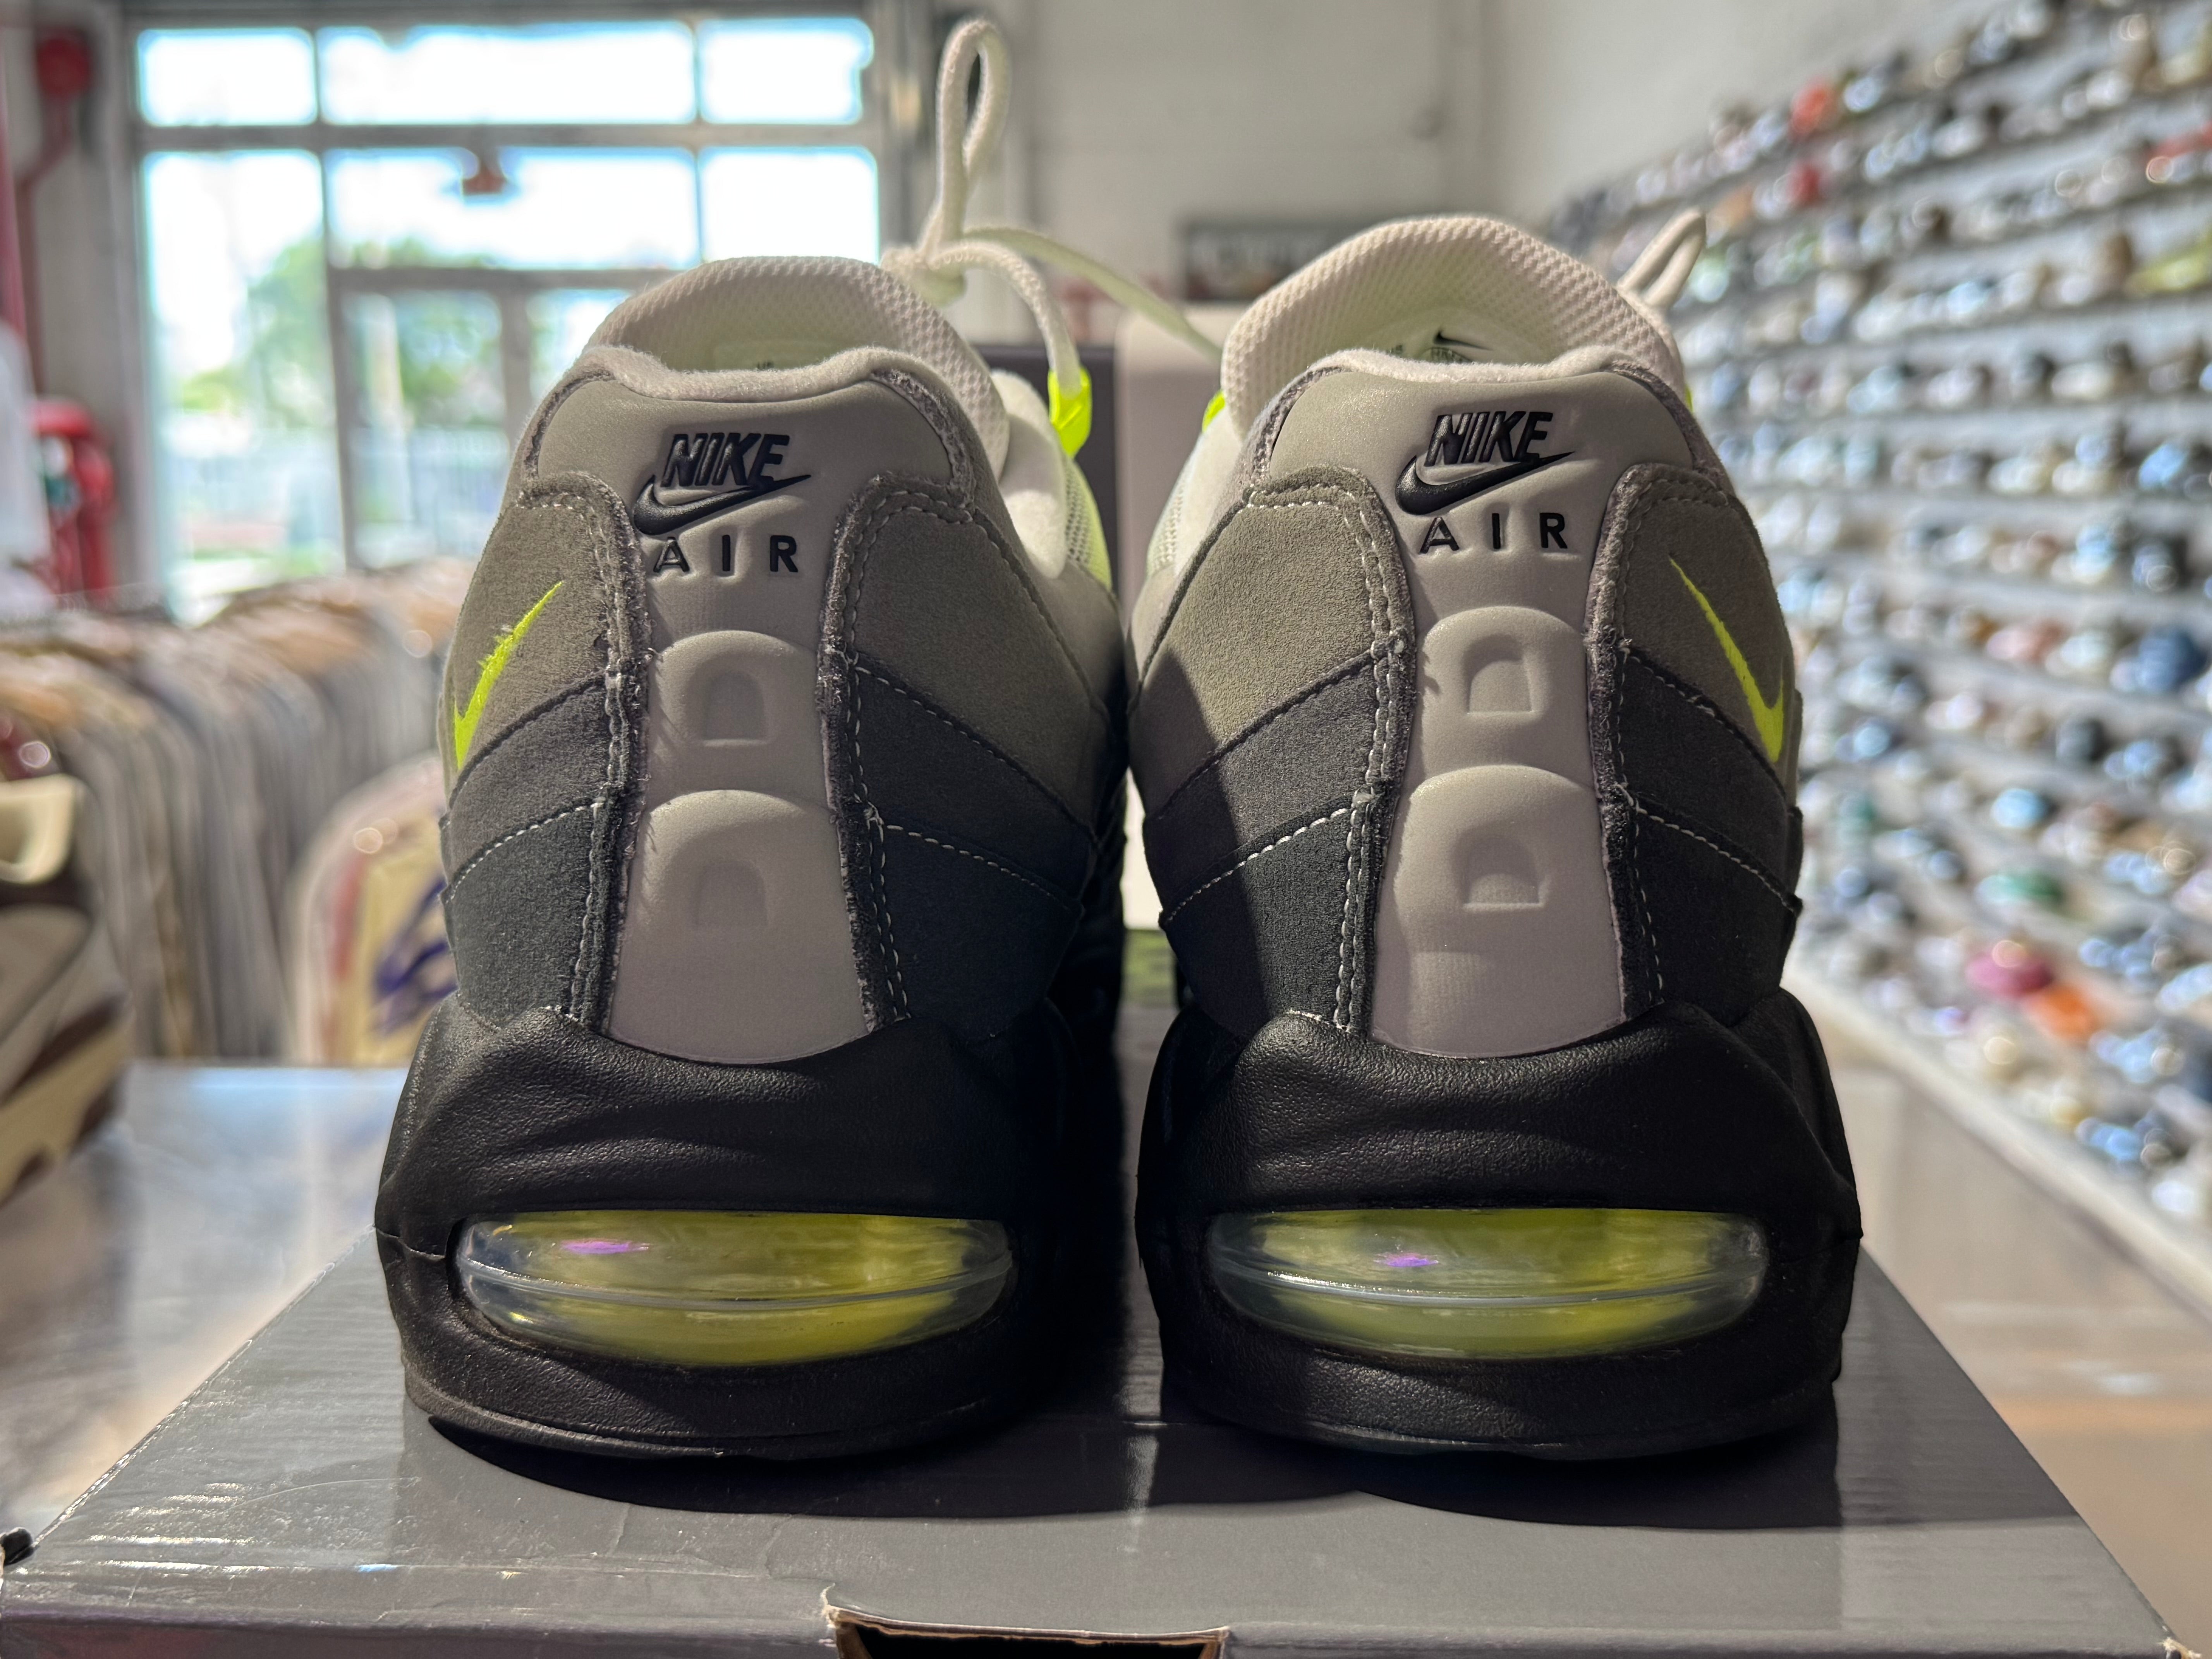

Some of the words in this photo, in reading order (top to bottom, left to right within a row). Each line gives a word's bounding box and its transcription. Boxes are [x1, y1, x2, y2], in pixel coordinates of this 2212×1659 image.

[660, 432, 790, 487] NIKE
[1424, 410, 1553, 467] NIKE
[653, 534, 799, 573] AIR
[1419, 512, 1568, 554] AIR
